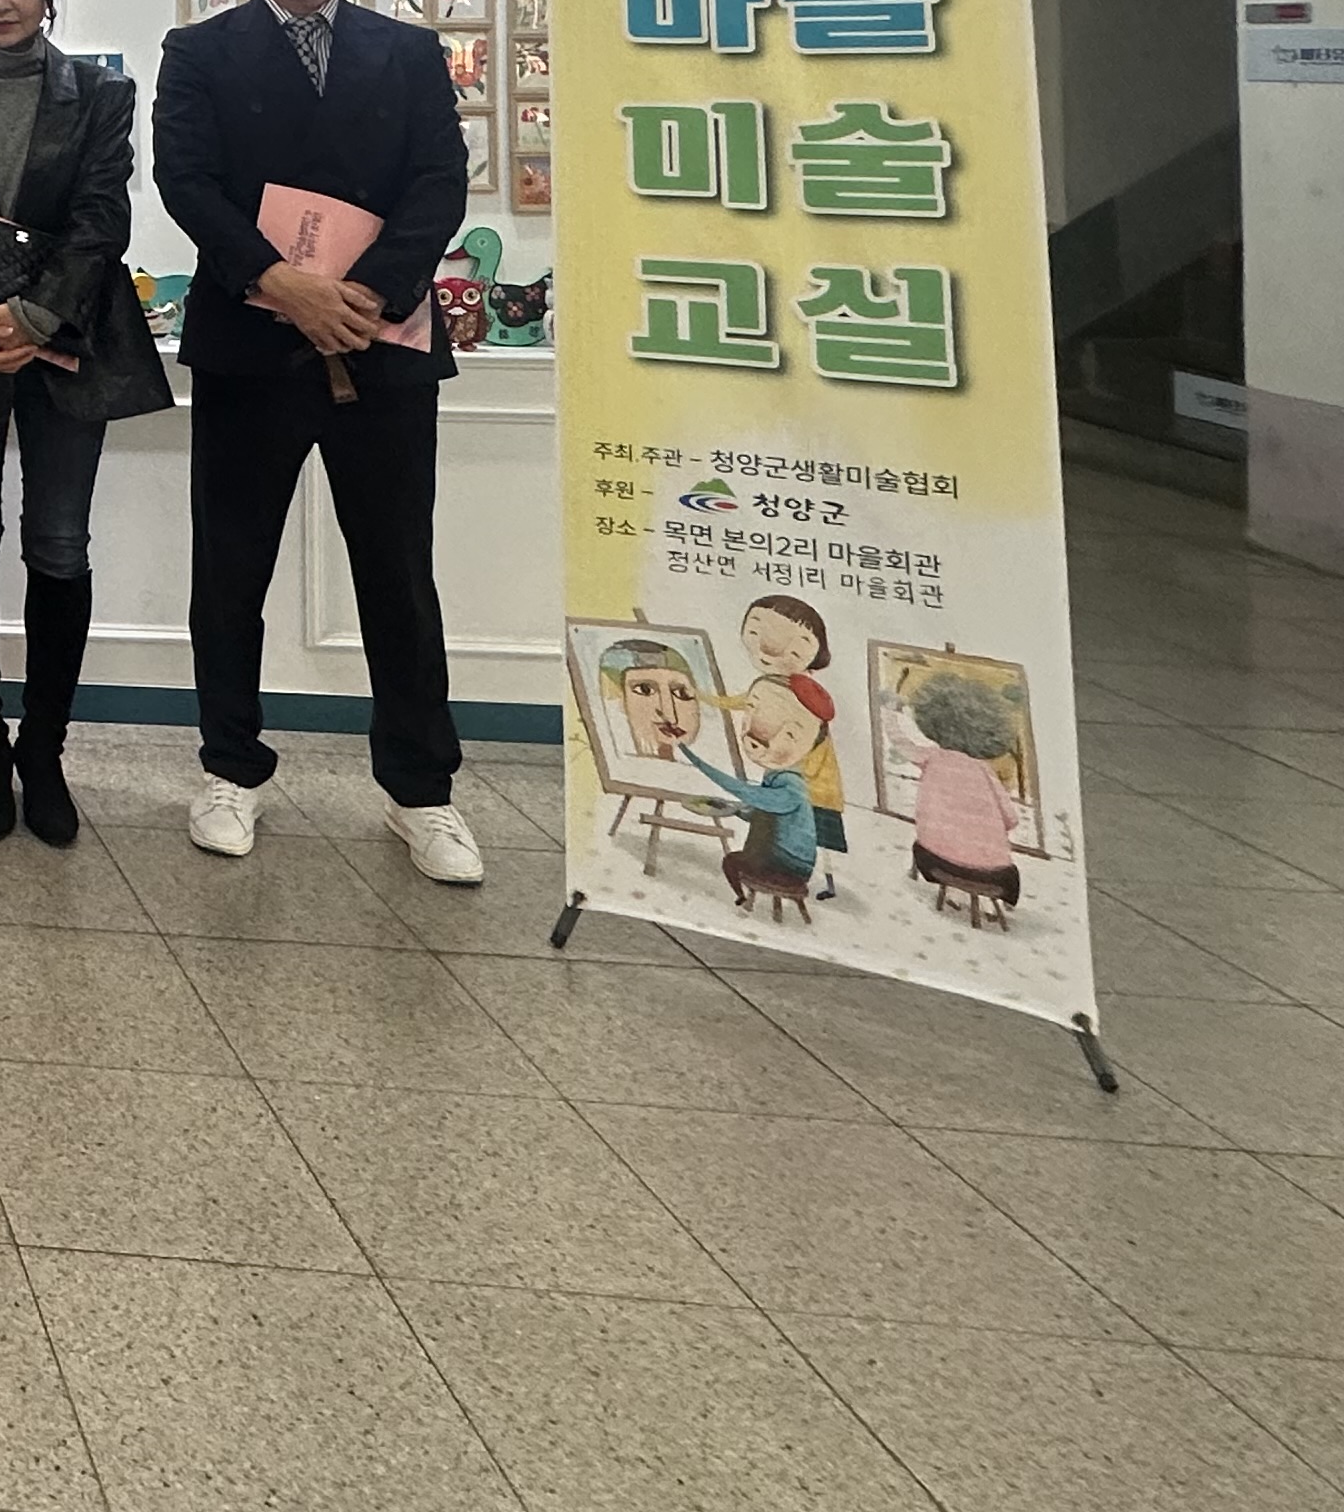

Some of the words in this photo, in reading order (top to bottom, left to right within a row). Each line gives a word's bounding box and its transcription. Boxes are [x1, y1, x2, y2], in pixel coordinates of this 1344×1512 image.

[615, 98, 952, 219] 미술
[626, 255, 959, 388] 교실
[594, 478, 635, 500] 후원
[752, 491, 851, 527] 청양군
[710, 449, 959, 500] 청양군생활미술협회
[595, 516, 638, 536] 장소
[662, 520, 714, 548] 목면
[722, 528, 819, 563] 본의2리
[828, 542, 942, 580] 마을회관
[666, 550, 737, 578] 정산면
[840, 573, 945, 610] 마을회관
